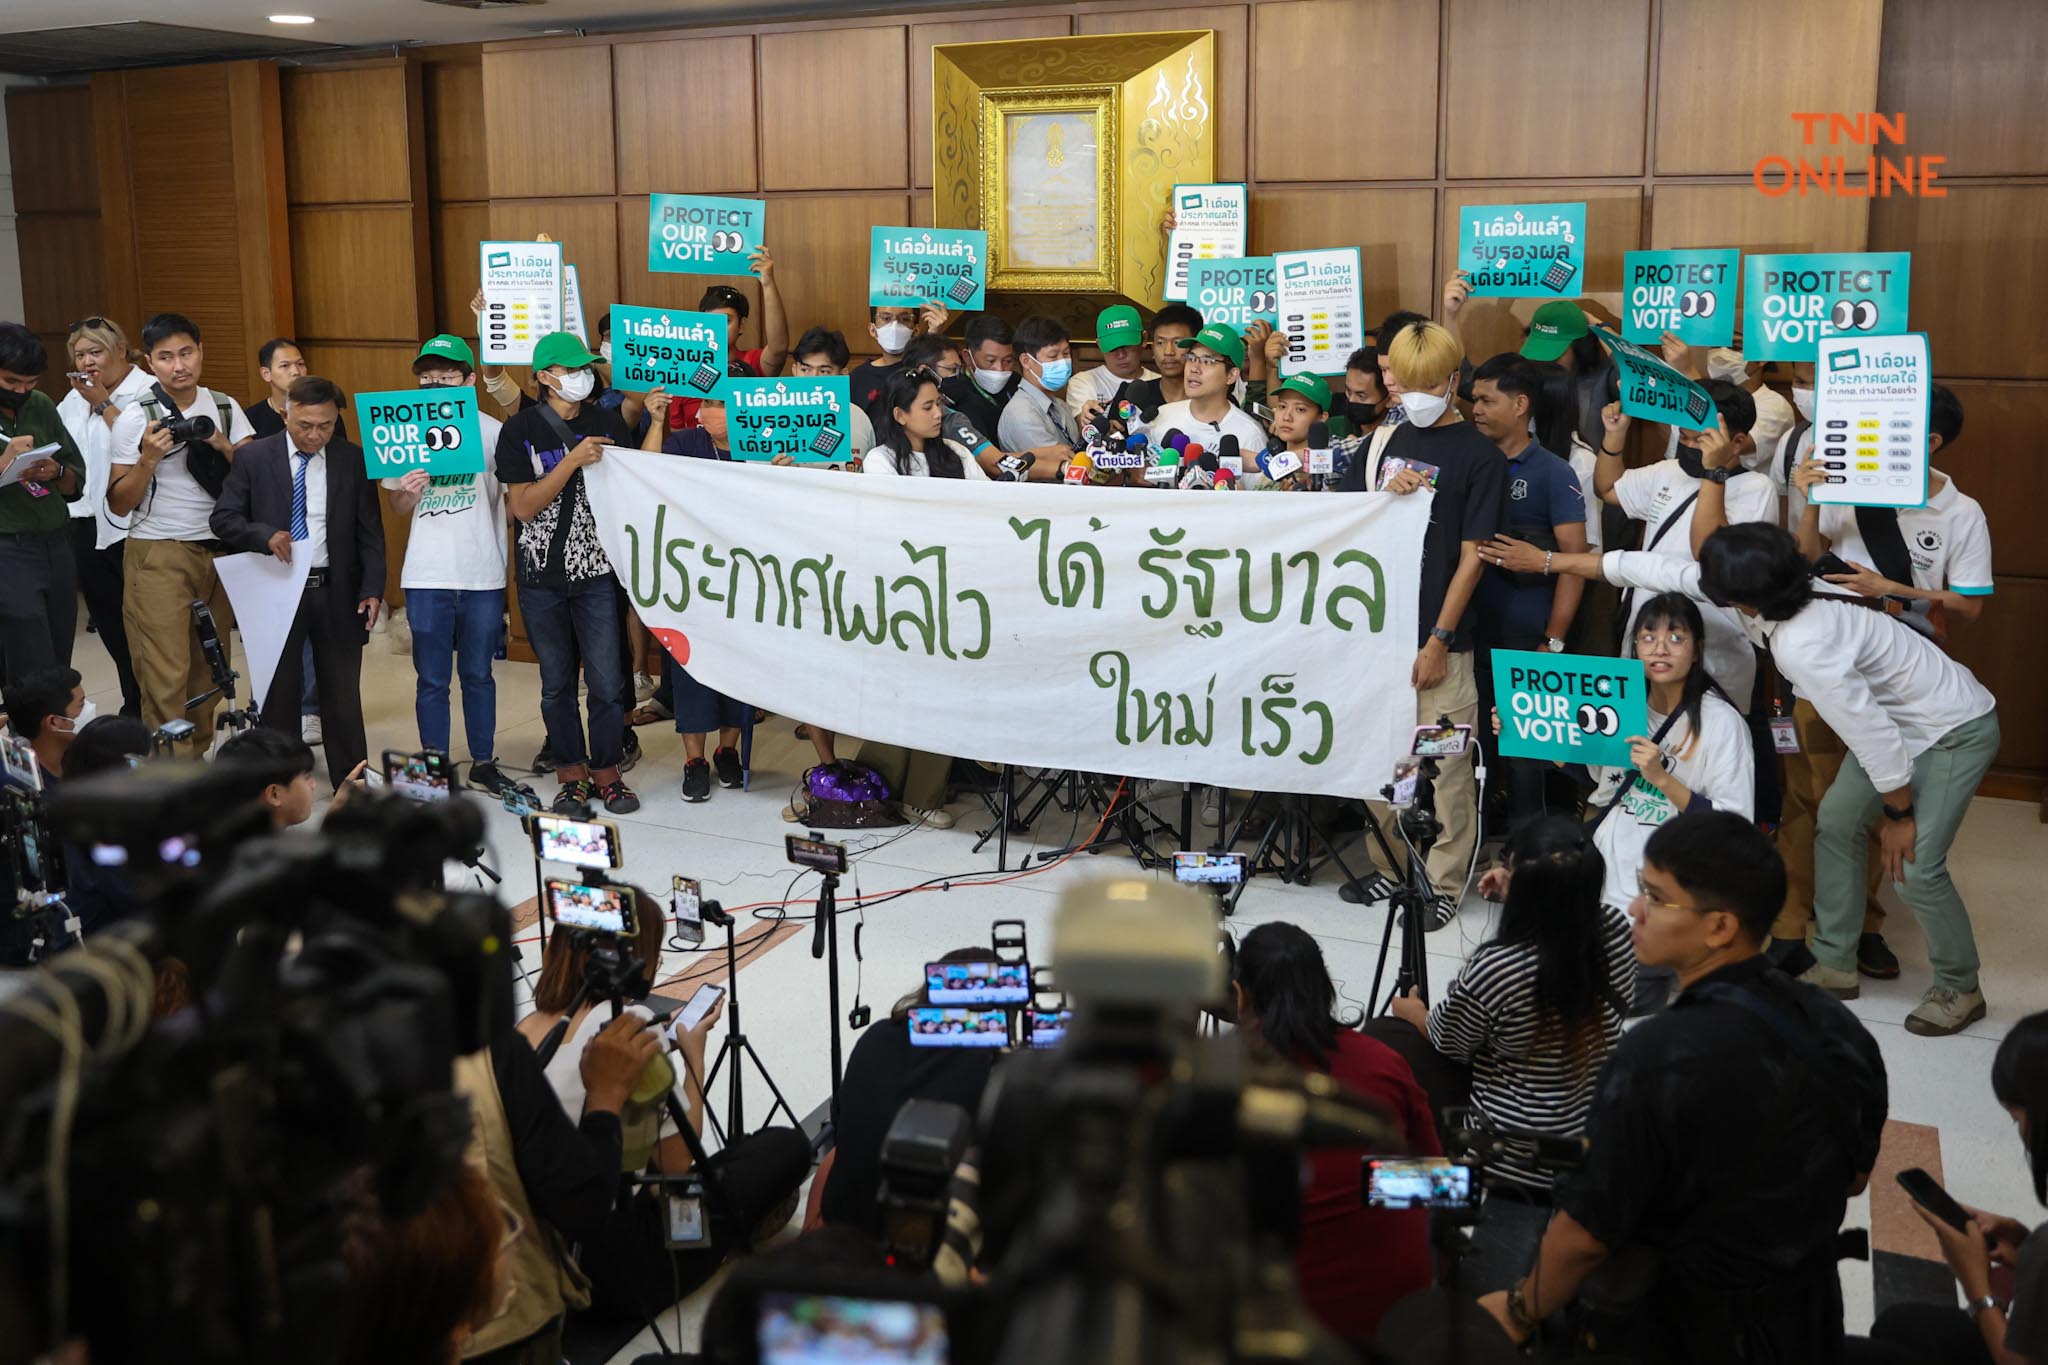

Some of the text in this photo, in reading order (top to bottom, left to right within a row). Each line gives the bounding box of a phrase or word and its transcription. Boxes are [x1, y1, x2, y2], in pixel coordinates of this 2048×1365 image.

[663, 206, 753, 228] PROTECT
[662, 224, 707, 243] OUR
[662, 242, 715, 262] VOTE
[1472, 240, 1570, 260] รับรองผล
[883, 256, 973, 277] รับรองผล
[1200, 268, 1275, 287] PROTEC
[1635, 264, 1728, 285] PROTECT
[1763, 270, 1892, 293] PROTECT
[1200, 287, 1245, 306] OUR
[1632, 286, 1676, 307] OUR
[1762, 295, 1825, 318] OUR
[1199, 306, 1253, 325] VOTE
[1631, 308, 1682, 330] VOTE
[1762, 320, 1835, 343] VOTE
[624, 337, 715, 364] รับรองผล
[370, 400, 466, 425] PROTECT
[736, 409, 837, 429] รับรองผล
[372, 424, 420, 444] OUR
[374, 443, 432, 465] VOTE
[1009, 516, 1110, 610] ได้
[1141, 527, 1386, 637] รัฐบาล
[1510, 667, 1629, 699] PROTECT
[1089, 651, 1334, 765] ใหม่ เร็ว
[1511, 691, 1570, 720] OUR
[1512, 716, 1583, 746] VOTE
